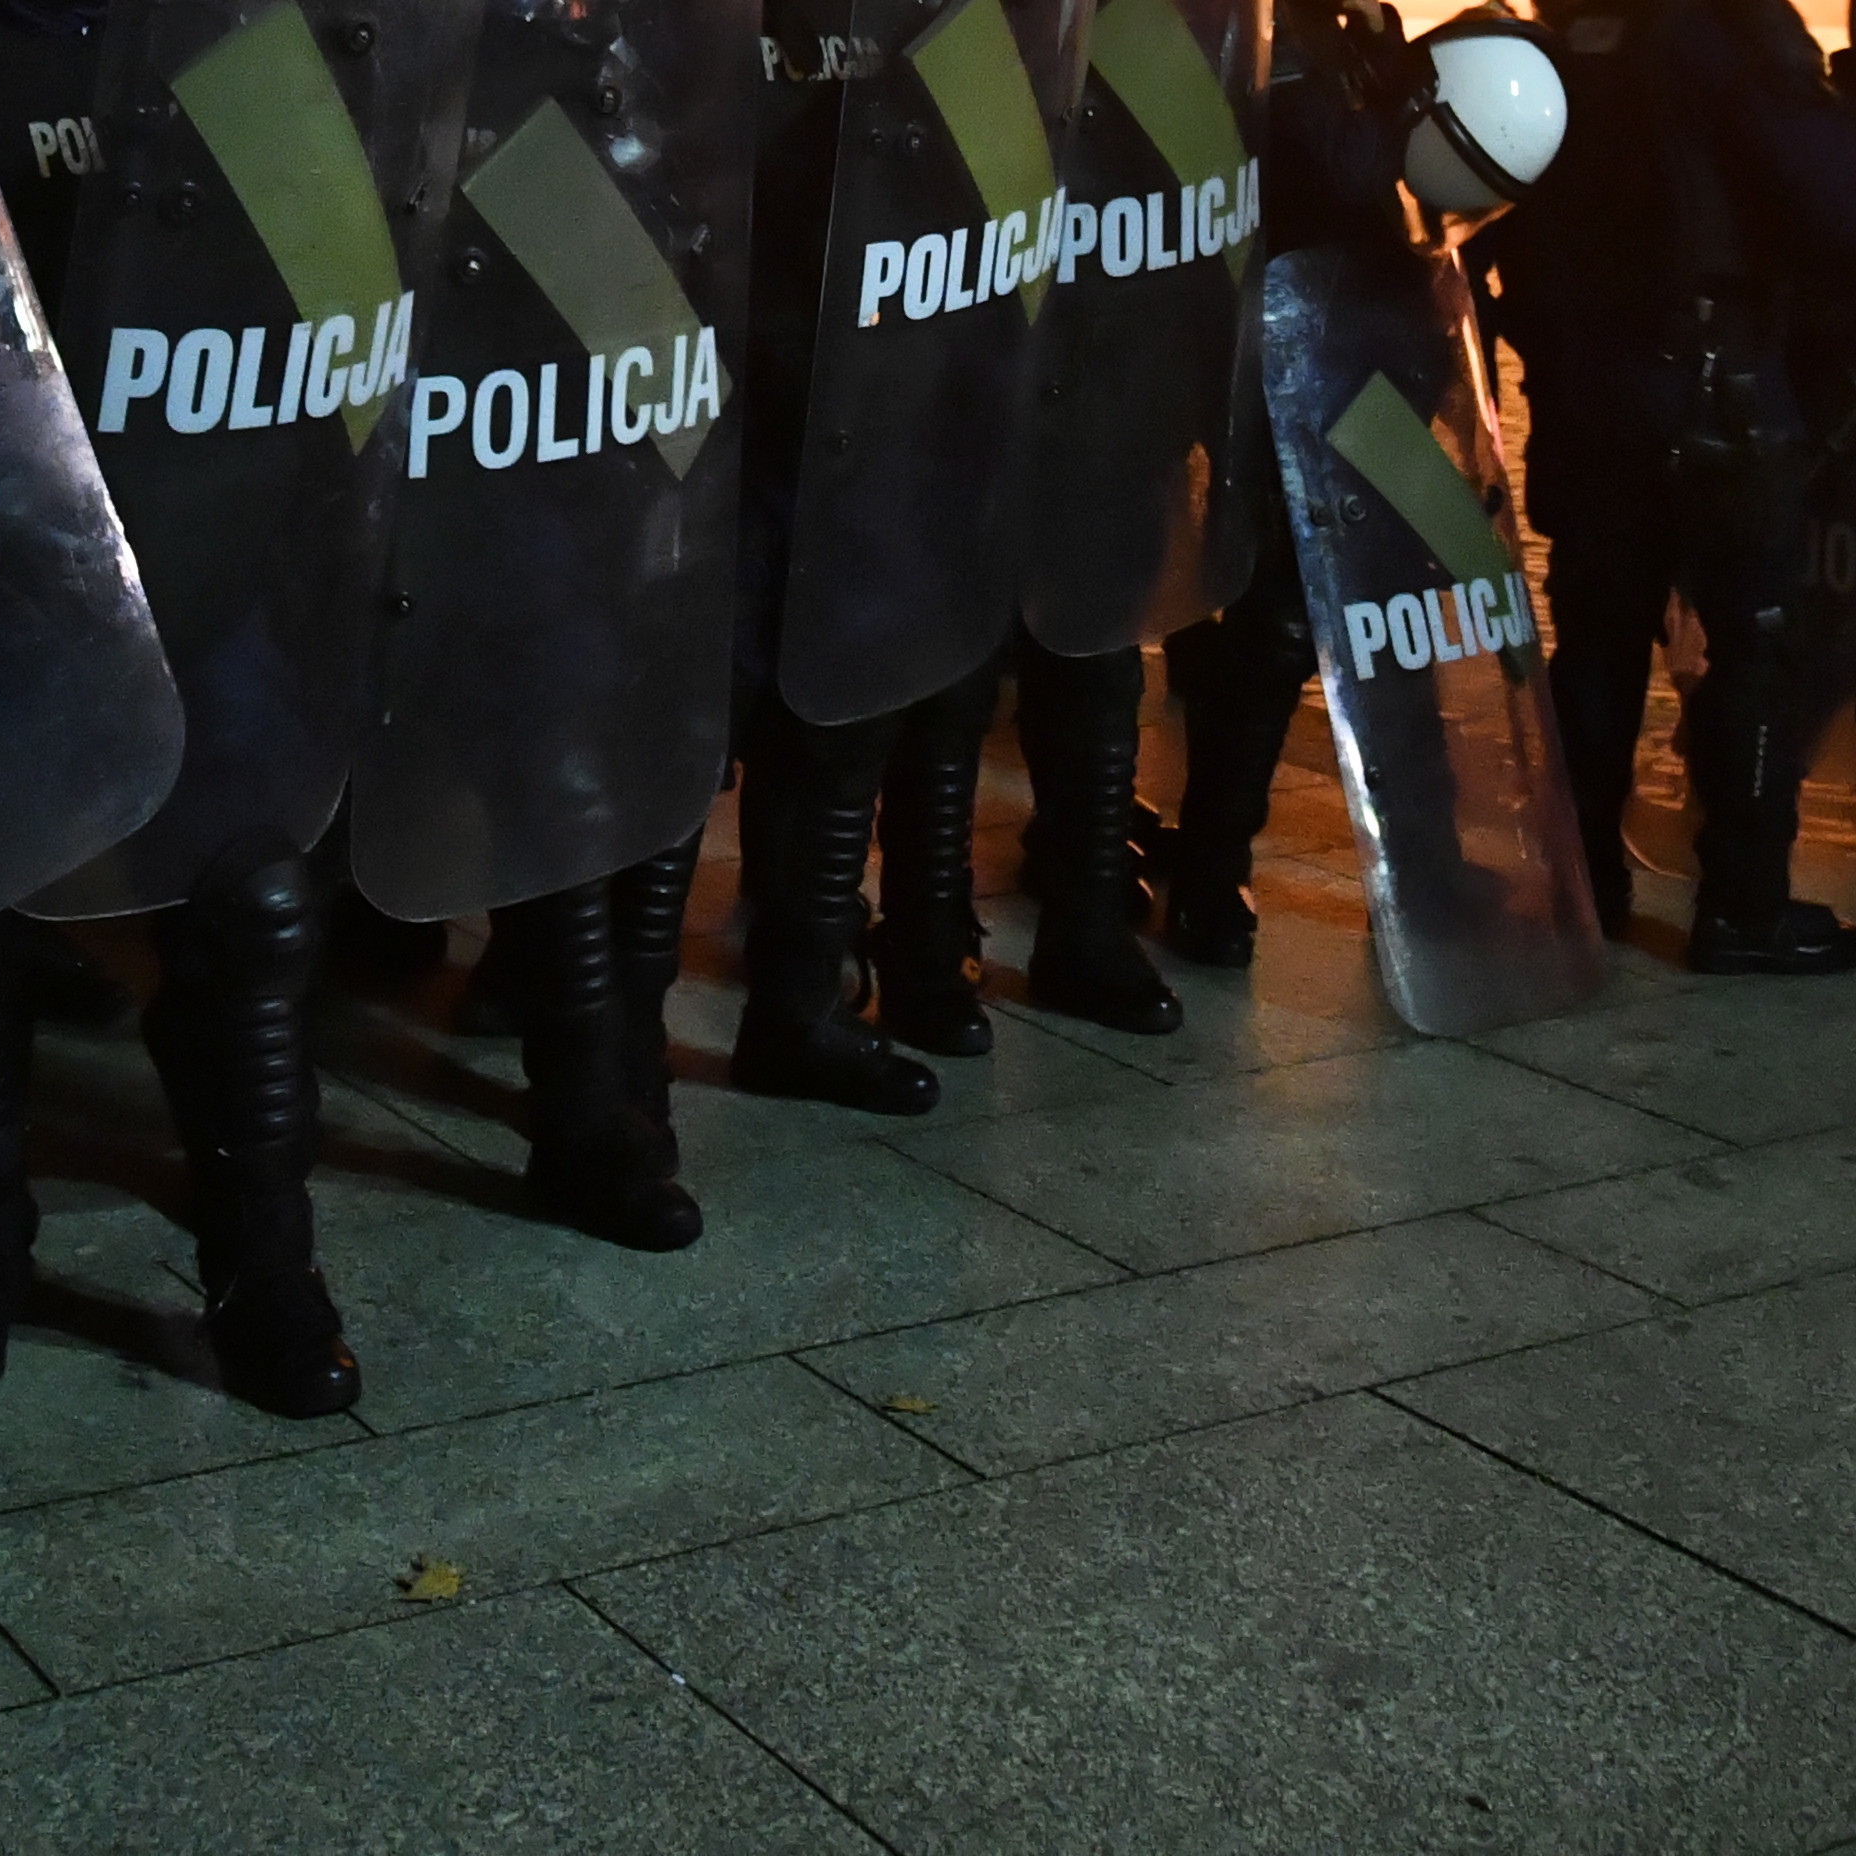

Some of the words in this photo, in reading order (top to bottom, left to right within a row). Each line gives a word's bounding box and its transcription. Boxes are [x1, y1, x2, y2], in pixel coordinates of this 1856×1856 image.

[857, 185, 1067, 329] POLICJA
[1056, 156, 1261, 284] POLICJA
[97, 290, 415, 434] POLICJA
[407, 323, 722, 480] POLICJA
